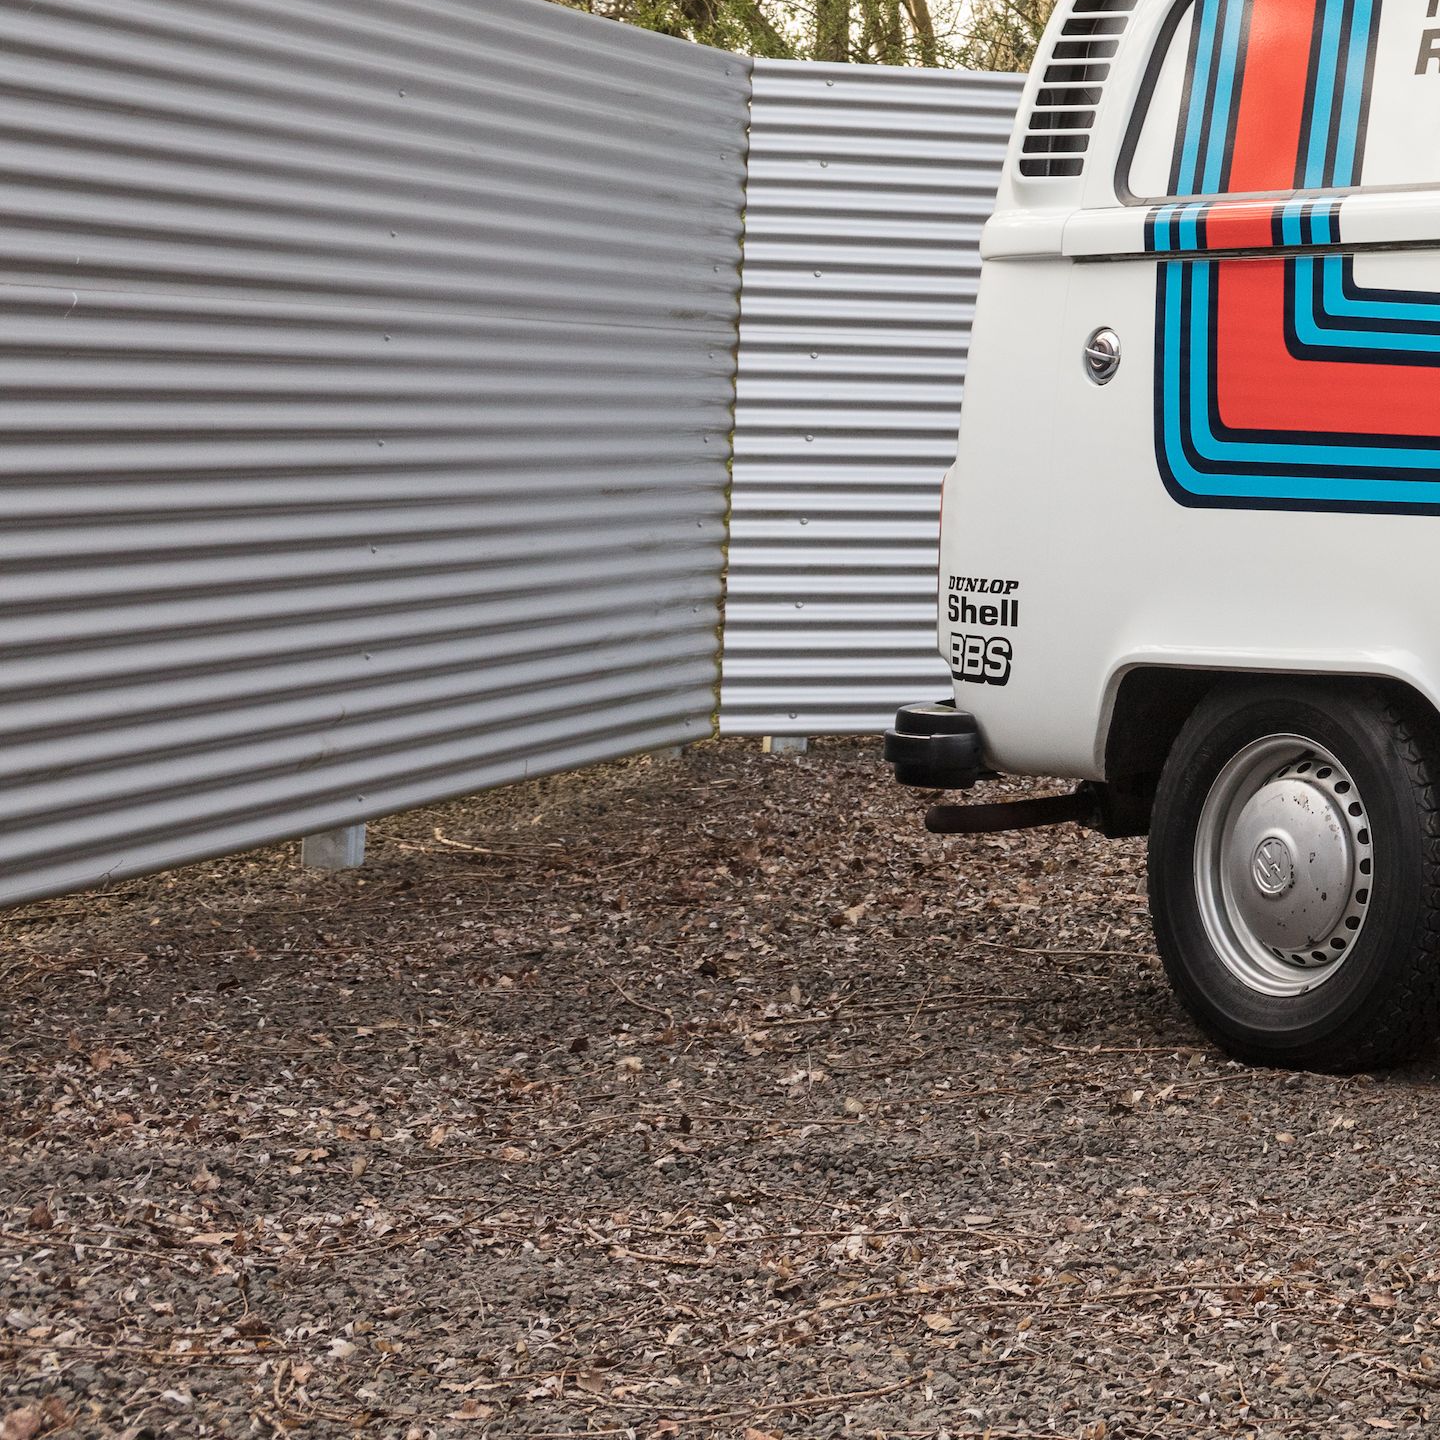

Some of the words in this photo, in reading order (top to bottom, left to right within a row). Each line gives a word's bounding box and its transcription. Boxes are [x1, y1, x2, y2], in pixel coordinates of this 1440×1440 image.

[948, 575, 1019, 595] DUNLOP
[948, 594, 1019, 627] Shell
[950, 631, 1013, 686] BBS
